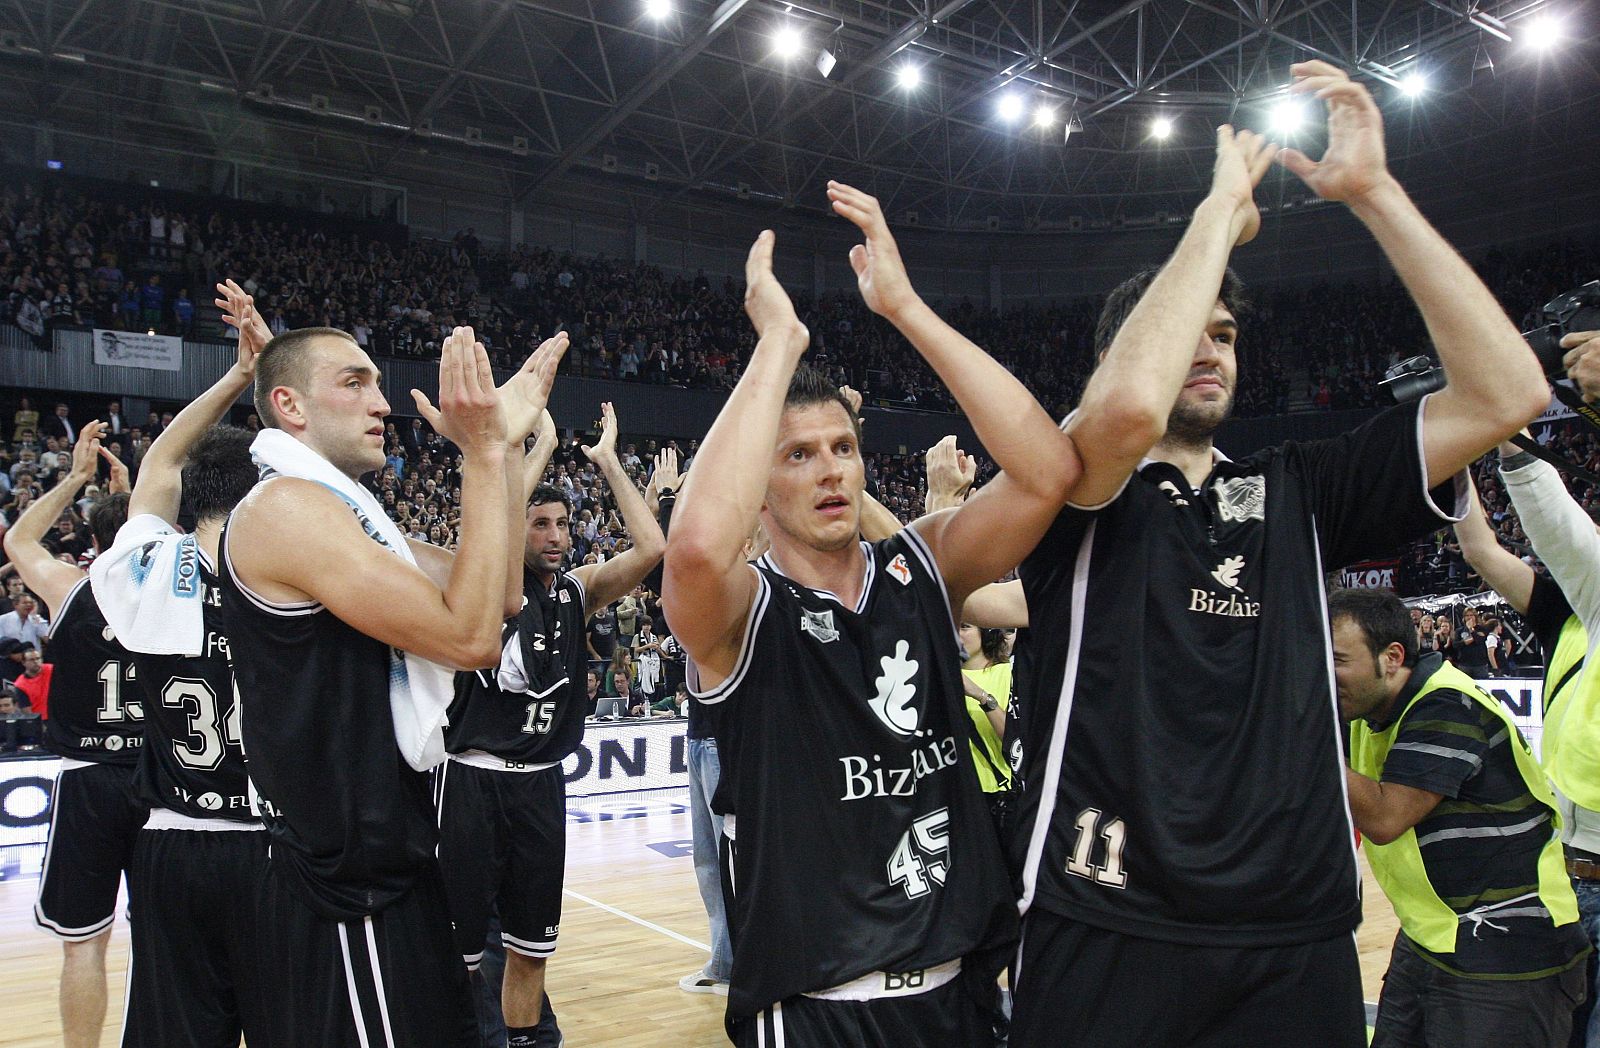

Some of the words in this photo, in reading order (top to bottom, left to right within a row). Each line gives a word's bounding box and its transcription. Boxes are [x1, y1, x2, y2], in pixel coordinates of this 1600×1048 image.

[521, 701, 556, 734] 15
[887, 806, 951, 900] 45
[1065, 807, 1128, 890] 11
